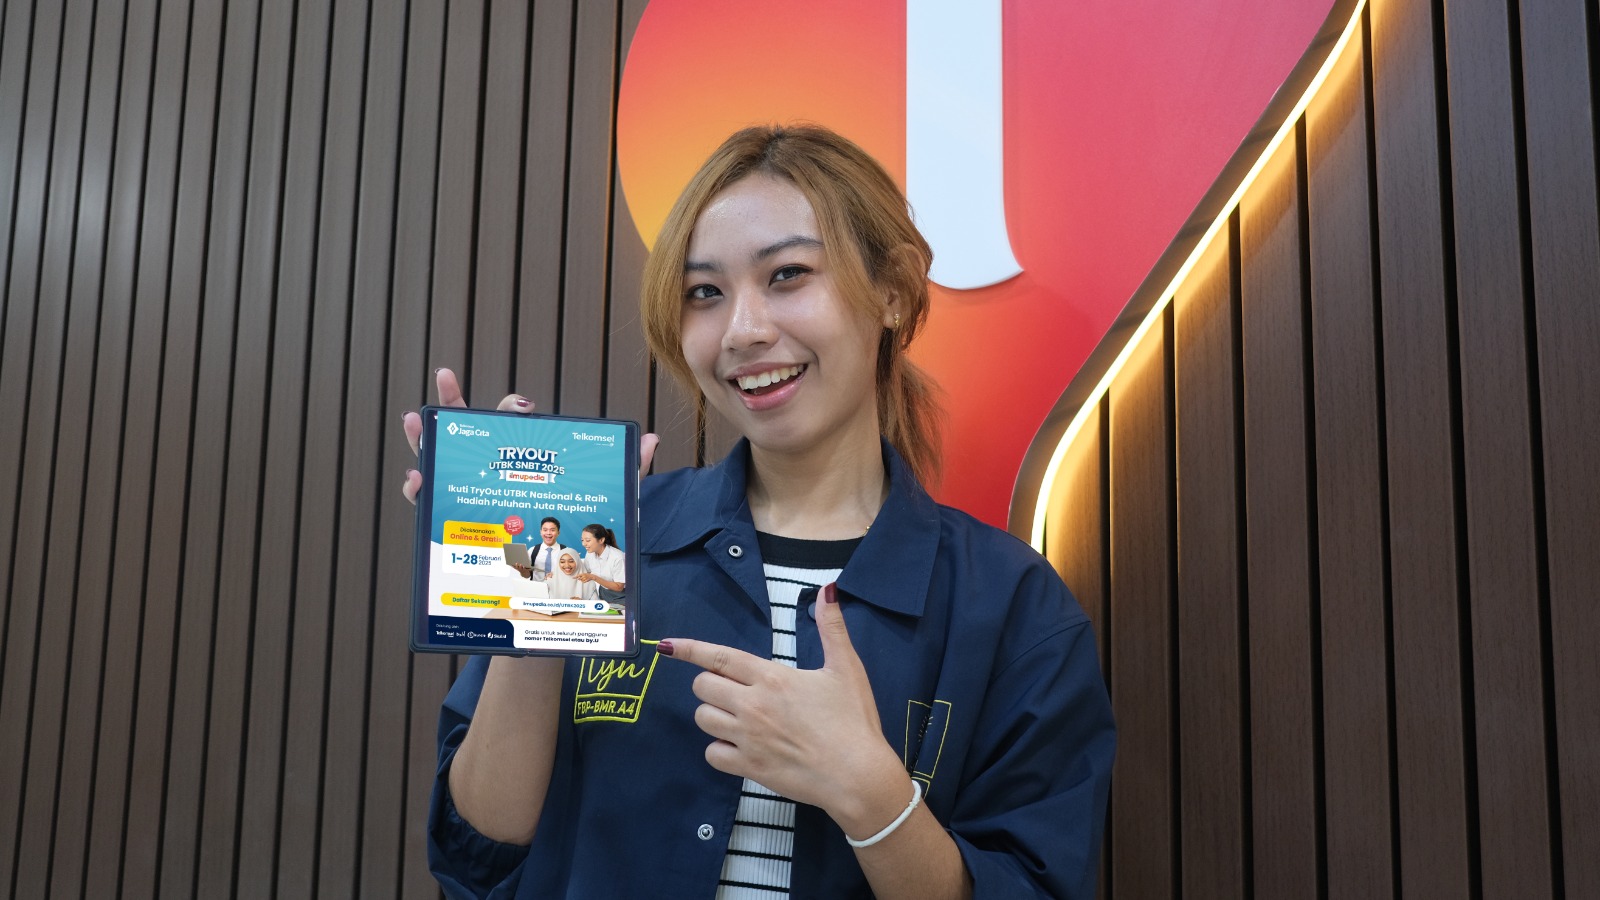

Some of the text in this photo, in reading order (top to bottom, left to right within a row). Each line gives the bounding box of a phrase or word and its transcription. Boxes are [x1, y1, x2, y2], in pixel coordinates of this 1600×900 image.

[458, 428, 490, 437] Jaga Cita
[572, 432, 614, 442] Telkomsel
[498, 446, 558, 464] TRYOUT
[489, 461, 564, 474] UTBK SNBT 2025
[509, 472, 544, 481] ilmupedia
[448, 484, 608, 502] Ikuti TryOut UTBK Nasional & Raih
[457, 496, 596, 514] Hadiah Puluhan Juta Rupiah!
[452, 553, 478, 565] 1-28
[617, 700, 636, 714] A4
